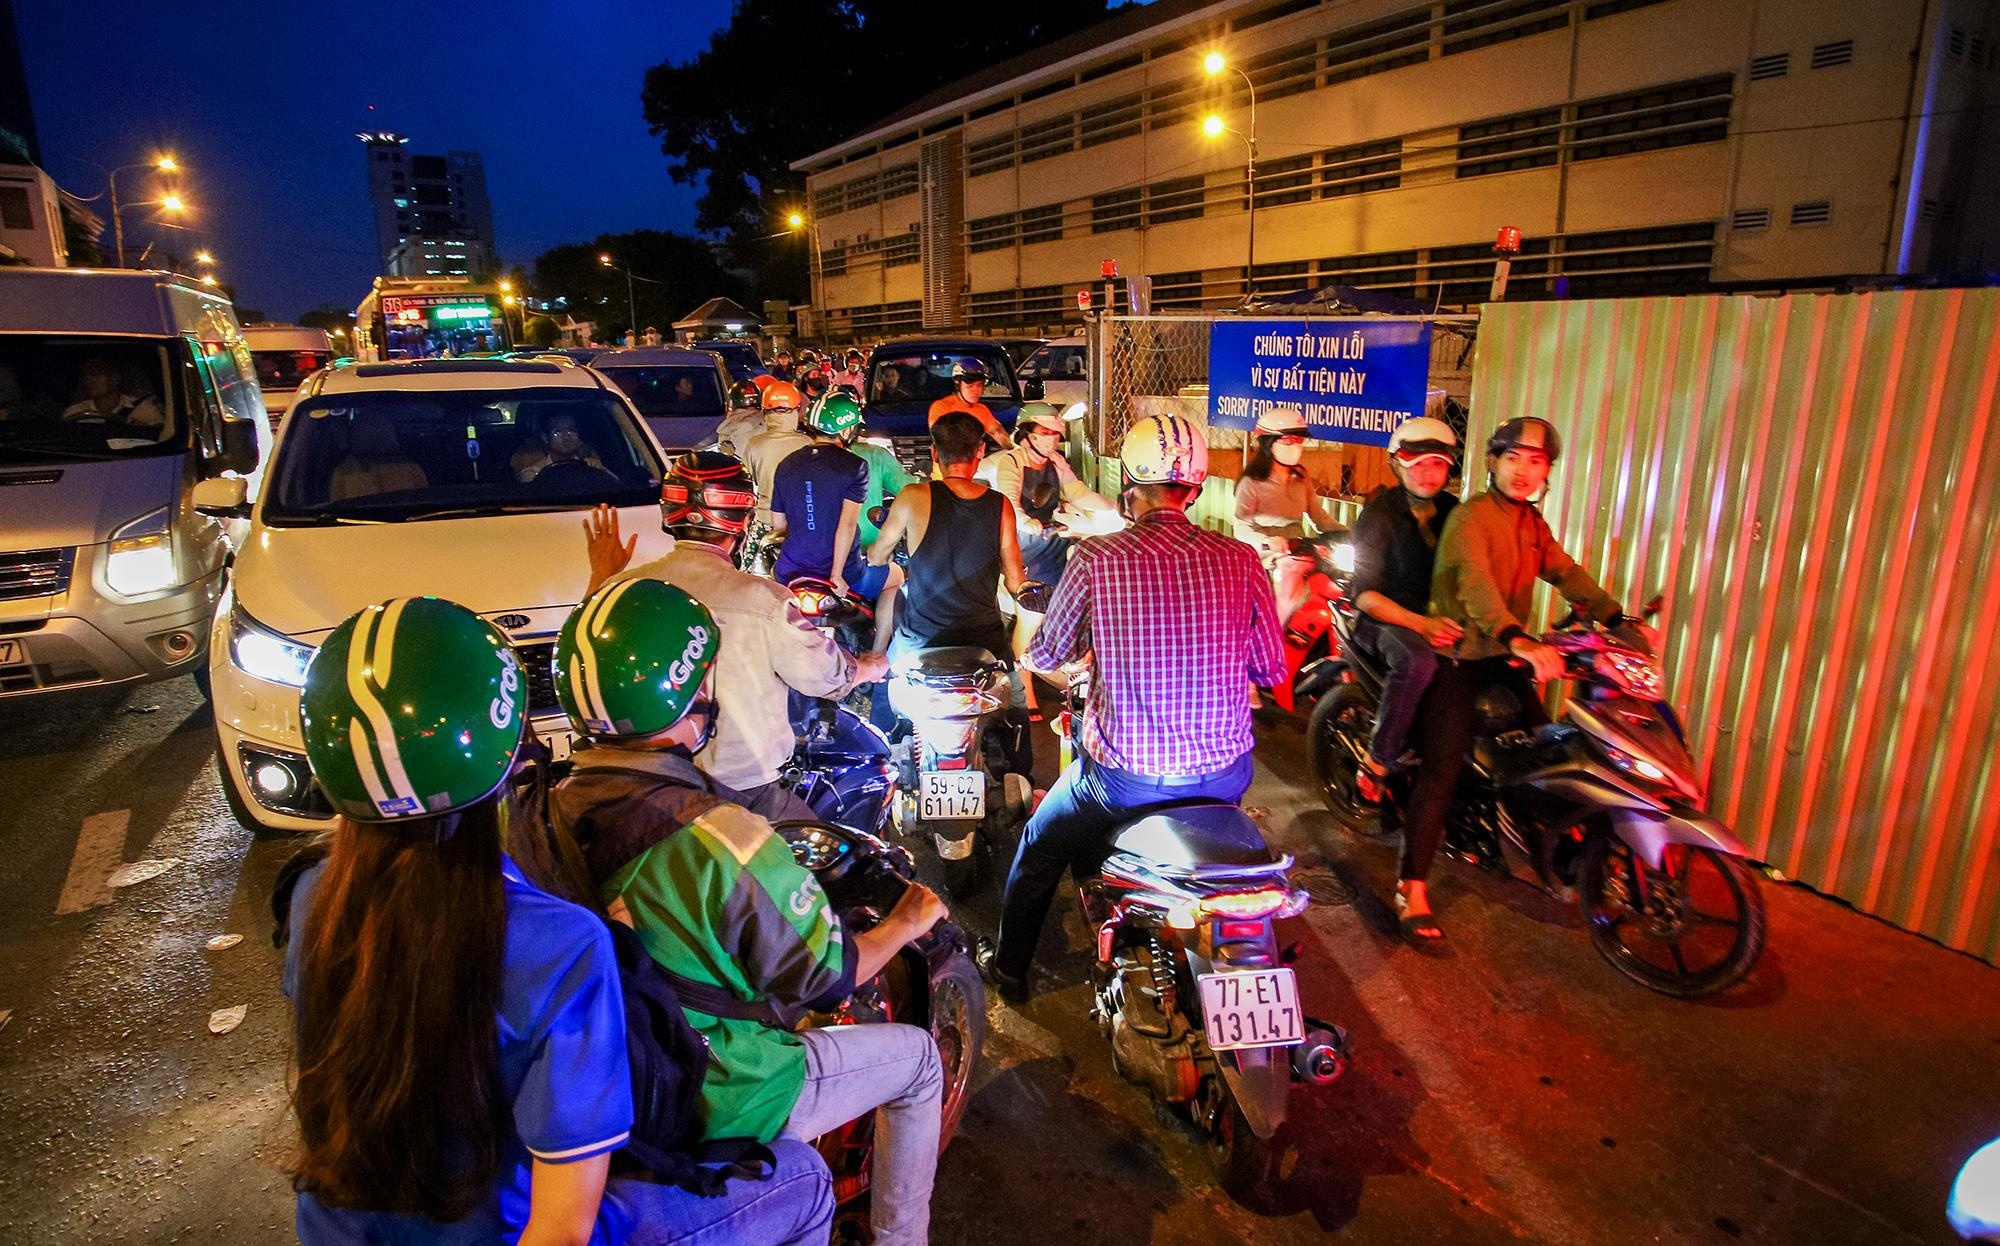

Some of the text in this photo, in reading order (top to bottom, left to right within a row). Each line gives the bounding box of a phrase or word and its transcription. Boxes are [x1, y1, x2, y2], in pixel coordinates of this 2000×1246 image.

[1254, 330, 1365, 360] CHÚNG TÔI XIN LỖI
[1251, 362, 1366, 395] VÌ SỰ BẤT TIỆN NÀY
[836, 410, 856, 426] Grab
[1217, 395, 1250, 418] SORRY
[496, 615, 526, 627] KIA
[669, 625, 709, 685] Grab
[490, 648, 518, 730] Grab
[930, 776, 975, 795] 59-C2
[925, 797, 980, 816] 611.47
[1215, 974, 1281, 1009] 77-E1
[1212, 1007, 1293, 1044] 131.47
